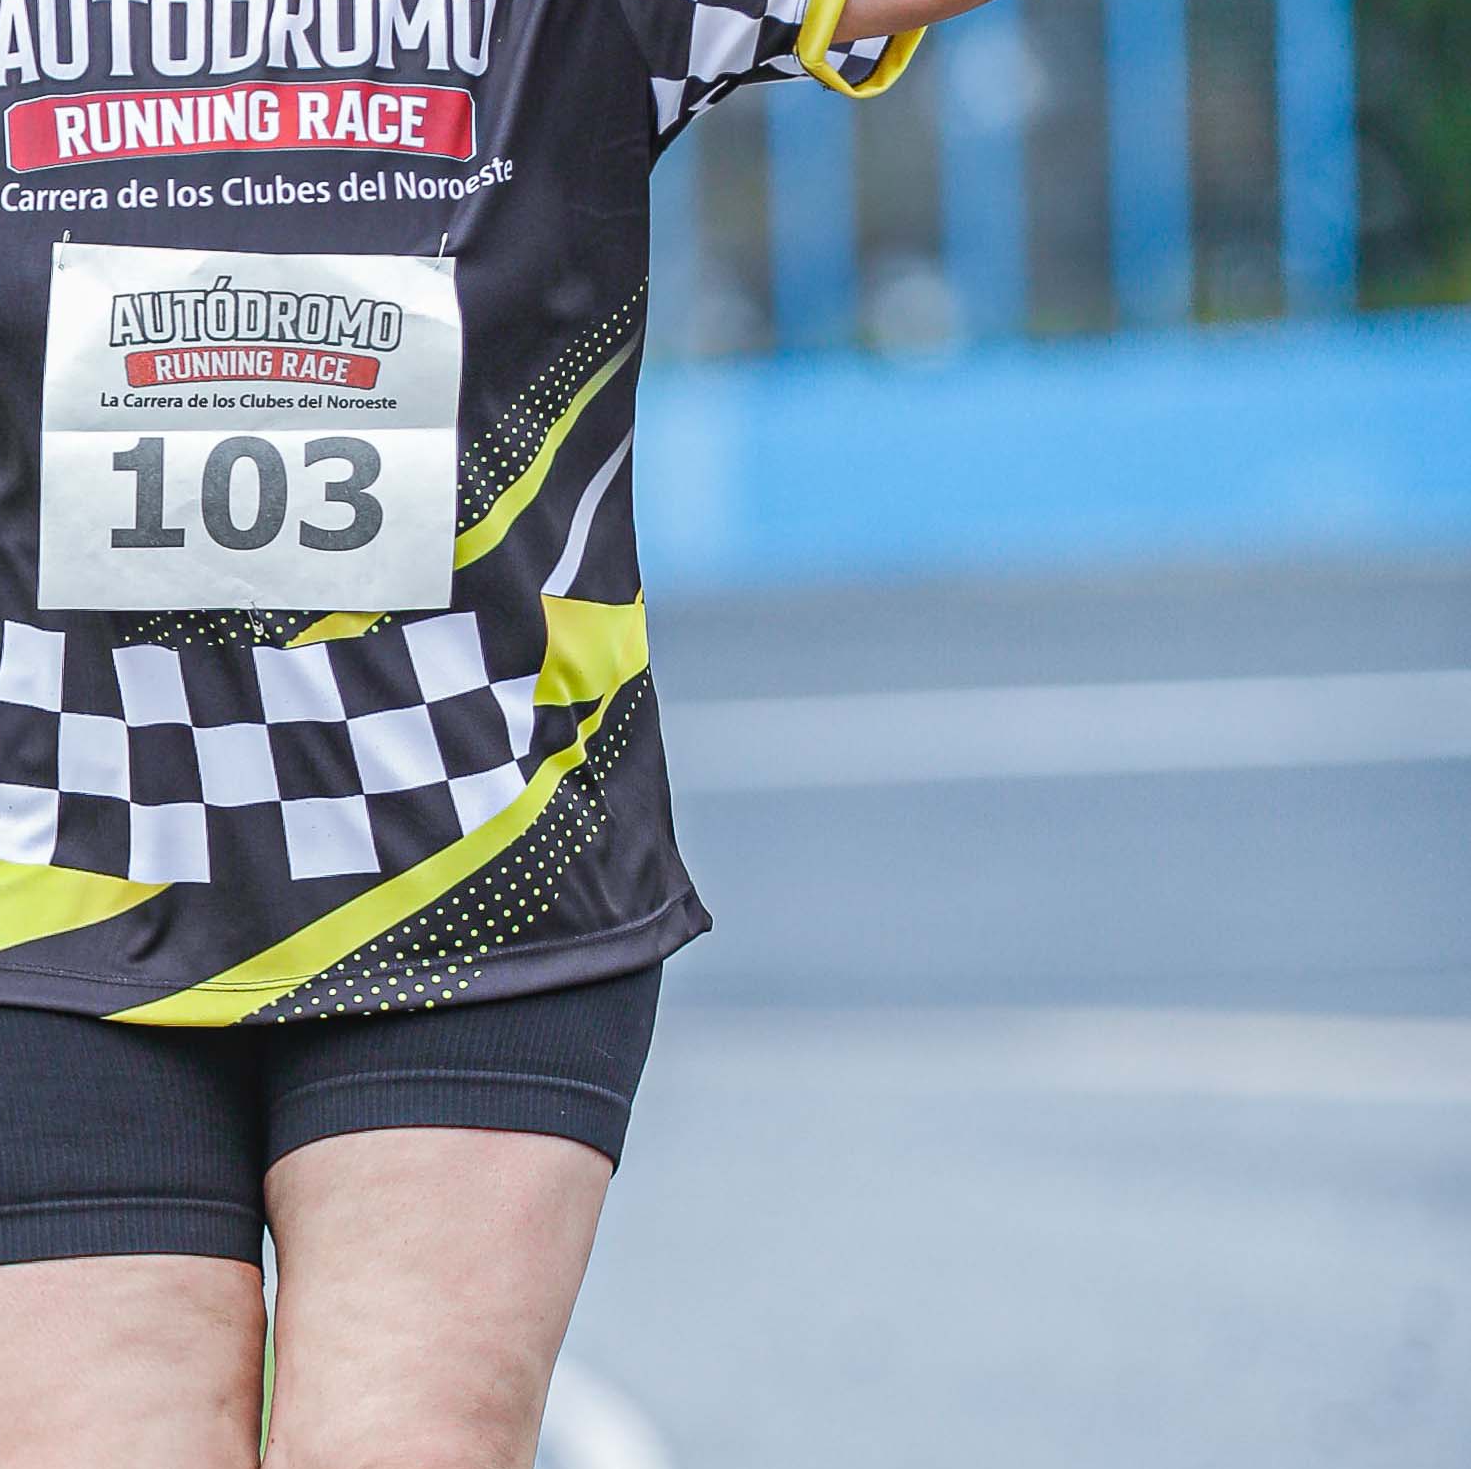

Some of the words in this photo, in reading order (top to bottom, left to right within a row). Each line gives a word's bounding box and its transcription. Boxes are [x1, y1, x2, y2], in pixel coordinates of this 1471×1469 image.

[53, 89, 281, 159] RUNNING
[297, 90, 428, 149] RACE
[0, 182, 108, 212] Carrera
[116, 172, 159, 210] de
[167, 171, 212, 208] los
[222, 169, 331, 207] Clubes
[337, 167, 387, 204] del
[395, 156, 514, 202] Noroeste
[109, 275, 403, 352] AUTÓDROMO
[154, 350, 273, 382] RUNNING
[282, 351, 352, 385] RACE
[100, 393, 119, 408] La
[123, 393, 184, 409] Carrera
[187, 393, 208, 409] de
[212, 393, 236, 410] los
[239, 393, 294, 410] Clubes
[298, 393, 323, 410] del
[327, 394, 397, 410] Noroeste
[110, 435, 384, 551] 103
